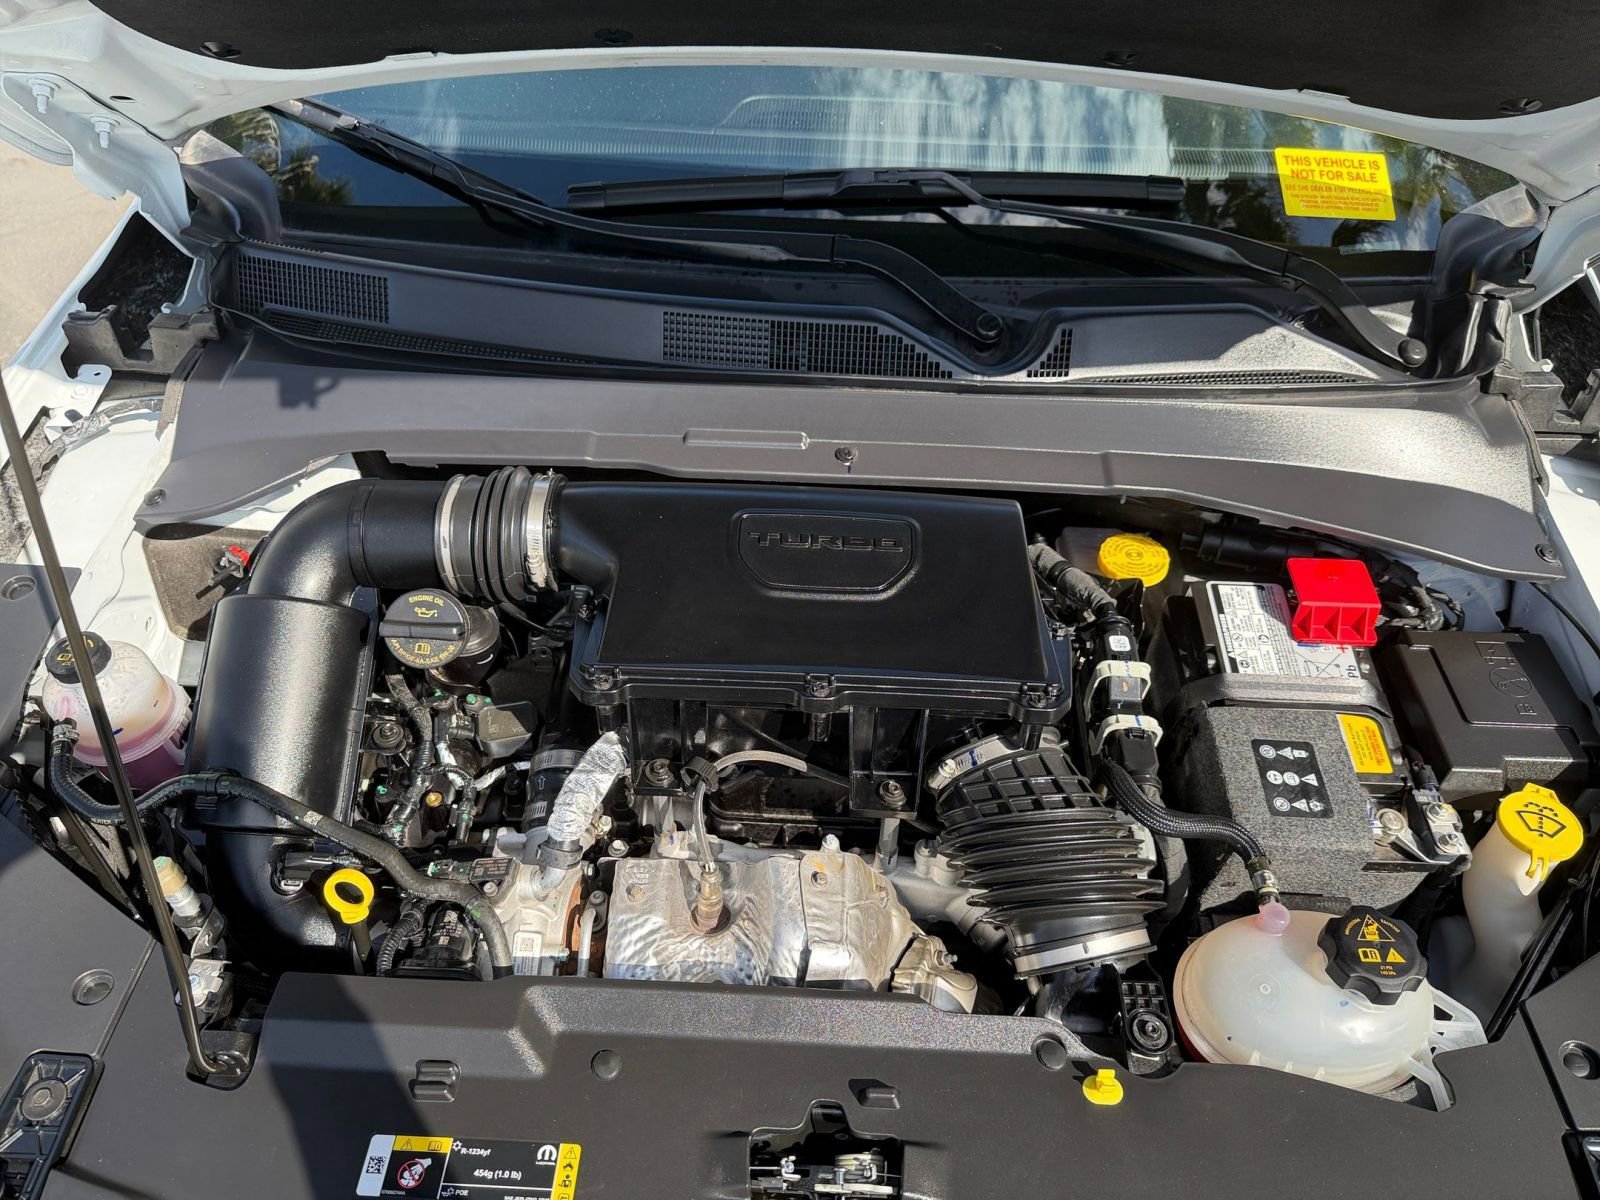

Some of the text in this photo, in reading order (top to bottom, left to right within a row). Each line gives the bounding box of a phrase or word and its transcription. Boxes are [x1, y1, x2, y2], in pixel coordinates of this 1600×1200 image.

[1283, 155, 1380, 171] THIS VEHICLE IS
[1291, 169, 1378, 183] NOT FOR SALE
[748, 532, 903, 552] TURBO
[408, 595, 444, 606] ENGINE OIL
[1348, 665, 1359, 679] Pb
[460, 1147, 491, 1157] R-1234yf
[473, 1169, 522, 1181] 454g (1.0 lb)
[455, 1189, 469, 1197] POE
